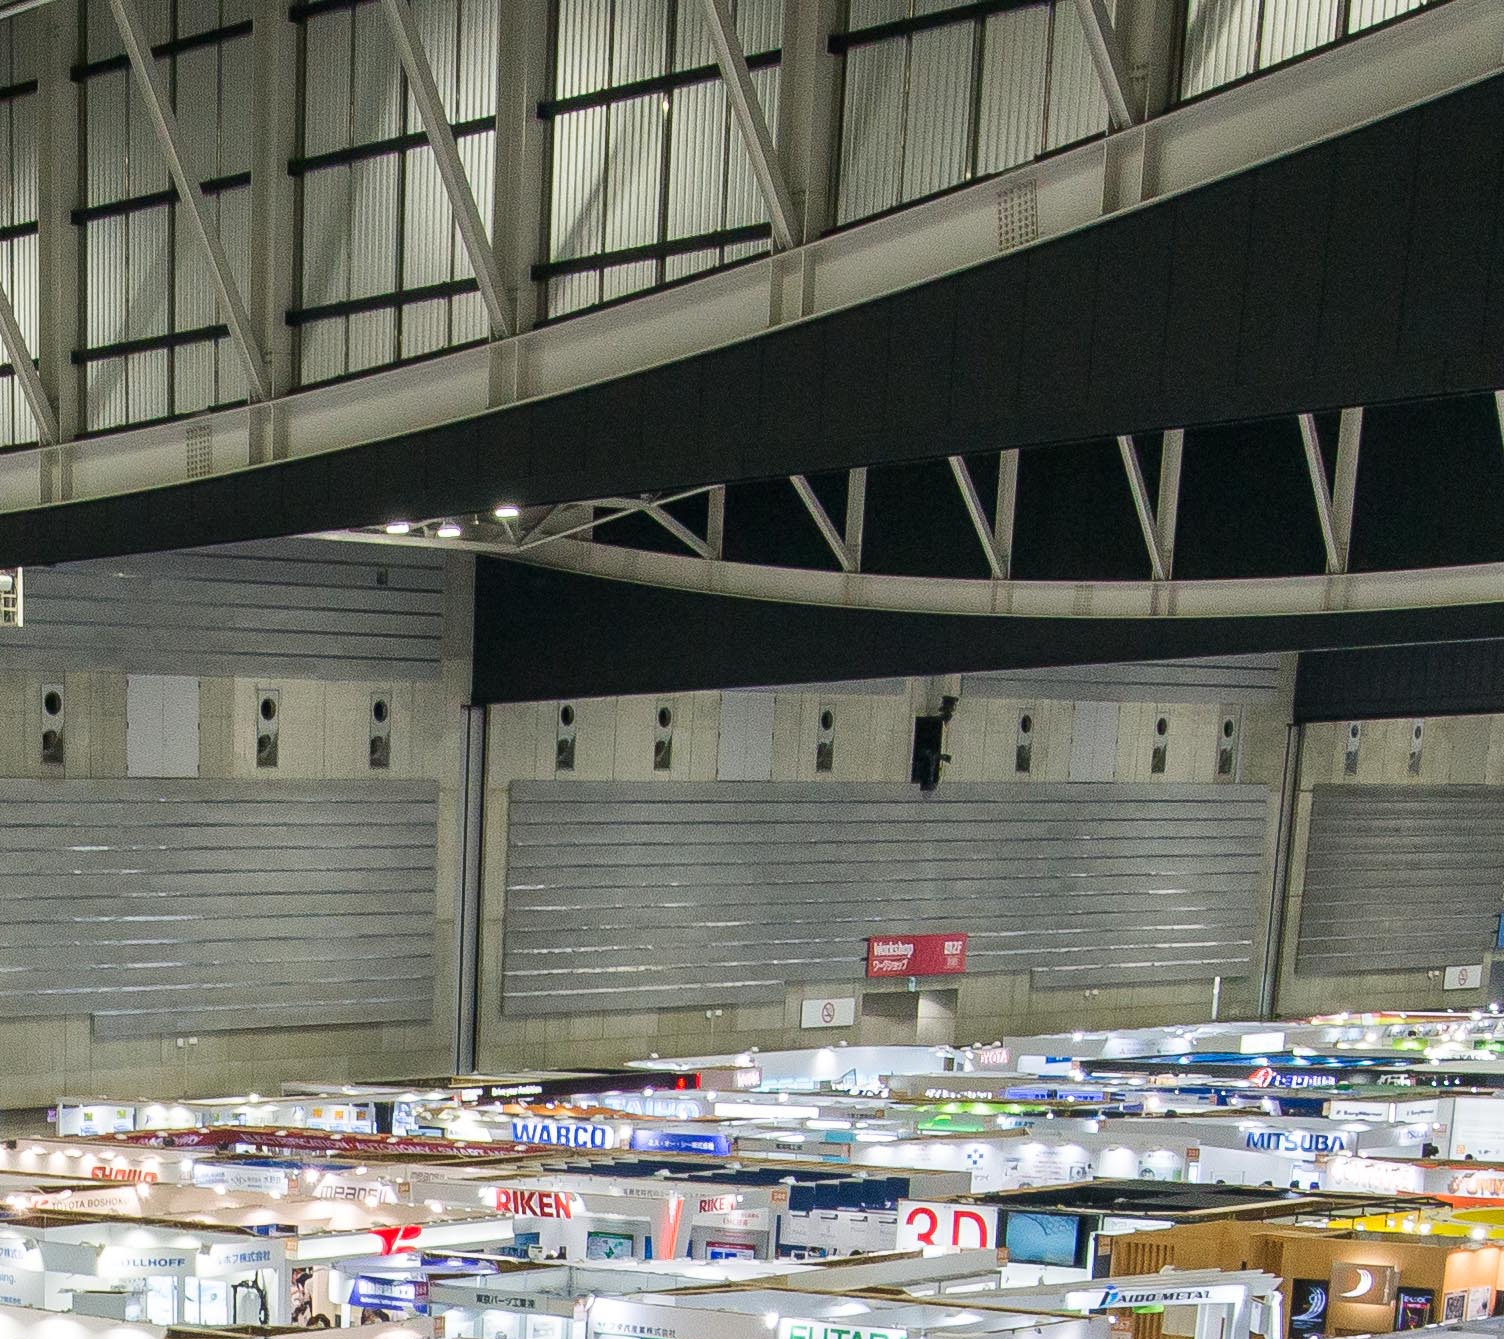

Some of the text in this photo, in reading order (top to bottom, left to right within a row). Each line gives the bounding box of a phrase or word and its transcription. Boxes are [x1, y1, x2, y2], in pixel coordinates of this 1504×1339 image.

[511, 1121, 605, 1150] WABCO
[1246, 1132, 1345, 1153] MITSUBA
[87, 1196, 124, 1209] BOSHOK
[495, 1188, 572, 1219] RIKEN
[906, 1207, 988, 1248] 3D
